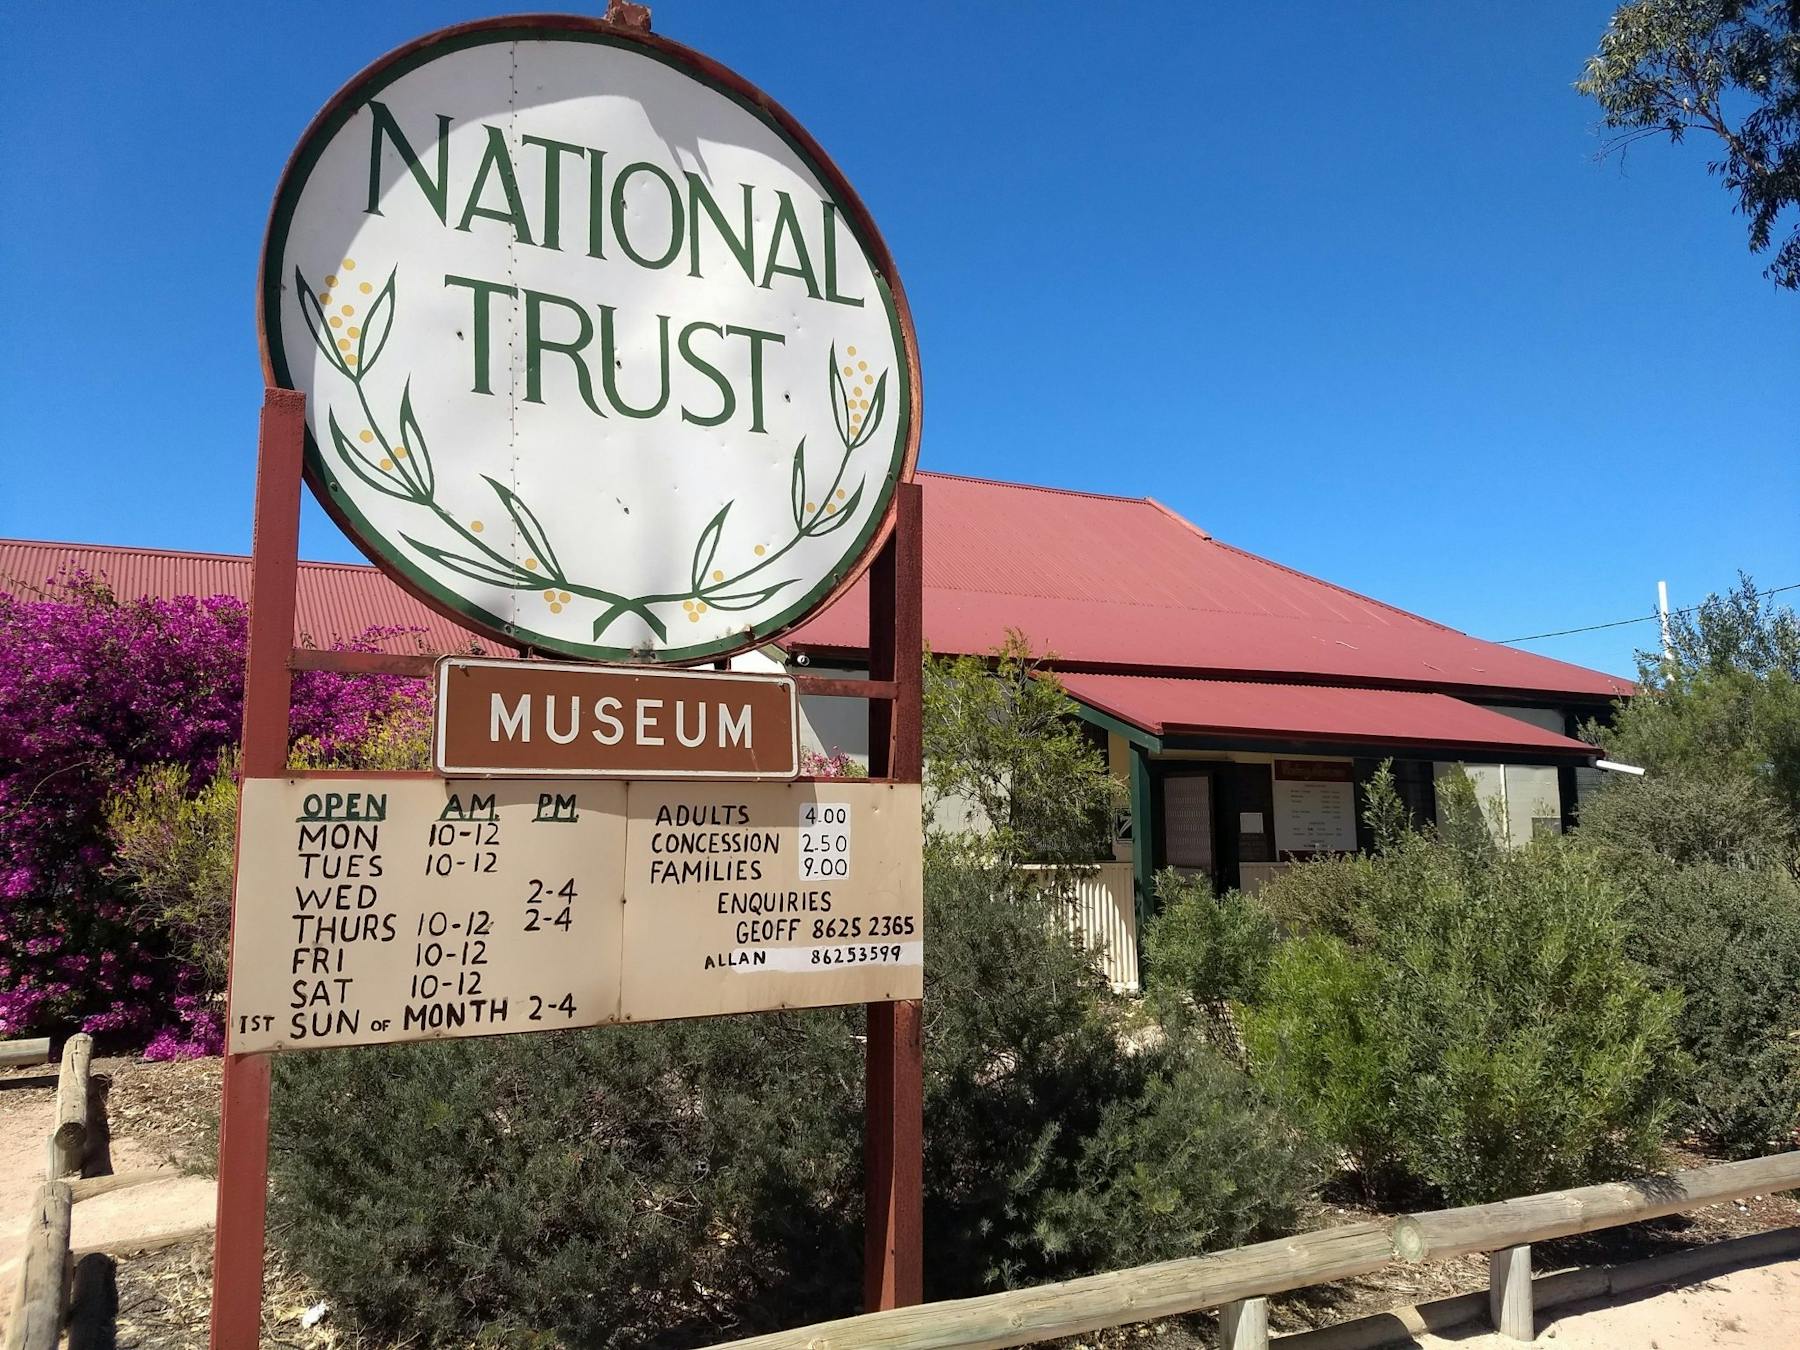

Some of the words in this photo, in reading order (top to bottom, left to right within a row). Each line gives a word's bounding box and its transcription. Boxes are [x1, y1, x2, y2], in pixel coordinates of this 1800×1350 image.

[362, 99, 865, 308] NATIONAL
[444, 274, 786, 434] TRUST
[490, 693, 752, 749] MUSEUM
[301, 793, 387, 820] OPEN
[655, 804, 750, 826] ADULTS
[805, 807, 846, 824] 4.00
[298, 824, 378, 851] MON
[428, 823, 500, 847] 10-12
[651, 833, 779, 854] CONCESSION
[802, 833, 847, 853] 2.50
[299, 853, 383, 878] TUES
[425, 852, 498, 876] 10-12
[650, 859, 762, 885] FAMILIES
[296, 885, 377, 910] WED
[526, 878, 578, 905] 2-4
[718, 891, 832, 916] ENQUIRIES
[292, 913, 397, 943] THURS
[417, 911, 490, 936] 10-12
[523, 907, 573, 932] 2-4
[736, 918, 801, 944] GEOFF
[812, 918, 861, 938] 8625
[868, 916, 915, 936] 2365
[292, 948, 344, 974] FRI
[416, 941, 488, 967] 10-12
[704, 950, 766, 970] ALLAN
[811, 945, 901, 965] 86253599
[290, 978, 353, 1009] SAT
[411, 971, 482, 999] 10-12
[290, 1009, 360, 1039] SUN
[371, 1019, 391, 1032] OF
[403, 998, 508, 1031] MONTH
[528, 992, 577, 1021] 2-4
